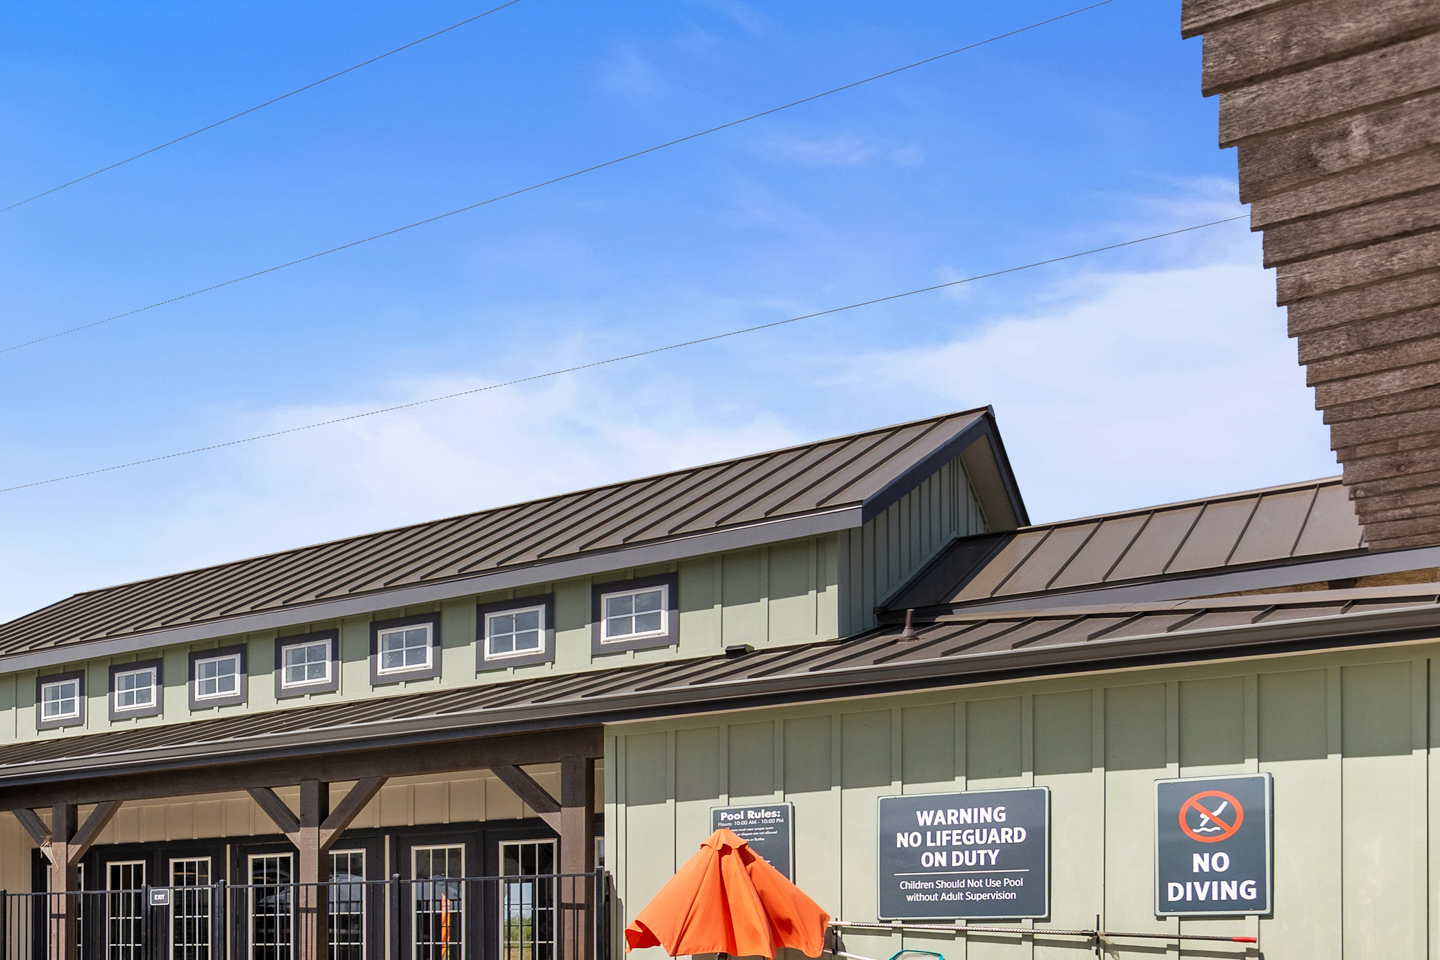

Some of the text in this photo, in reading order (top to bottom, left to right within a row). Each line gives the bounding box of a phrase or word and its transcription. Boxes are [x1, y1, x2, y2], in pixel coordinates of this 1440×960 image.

[720, 809, 781, 821] Pool Rules:
[916, 807, 1007, 826] WARNING
[896, 827, 1027, 848] NO LIFEGUARD
[921, 850, 1000, 868] ON DUTY
[1192, 852, 1230, 873] NO
[899, 878, 1024, 890] Children Should Not Use Pool
[1167, 880, 1257, 902] DIVING
[906, 891, 1017, 902] without Adult Supervision
